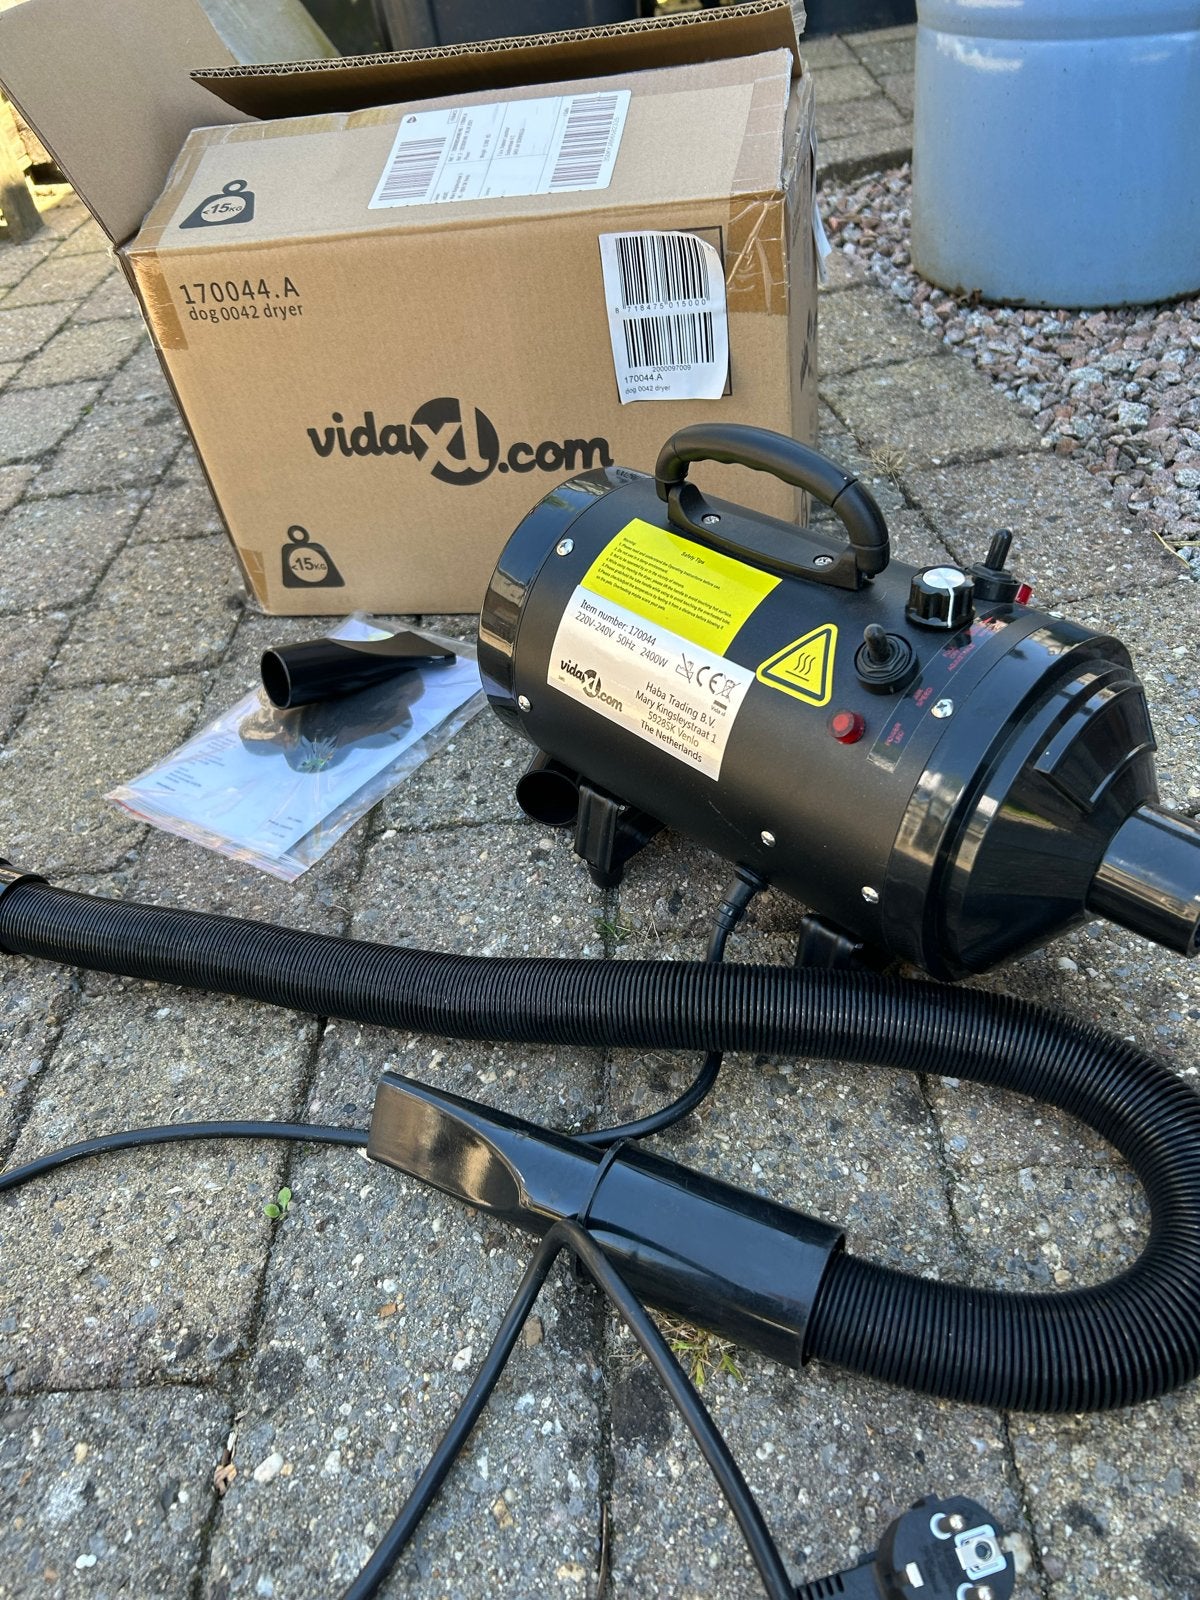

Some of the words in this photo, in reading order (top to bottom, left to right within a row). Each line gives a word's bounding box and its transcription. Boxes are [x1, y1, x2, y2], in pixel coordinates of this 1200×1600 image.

[179, 276, 300, 304] 170044.A
[263, 303, 303, 320] dryer
[624, 374, 663, 384] 170044.A
[652, 364, 692, 373] 2000097009
[625, 386, 637, 395] dog
[655, 385, 671, 393] dryer
[680, 551, 696, 561] Safety
[580, 599, 597, 614] Item
[598, 610, 627, 632] number:
[629, 625, 656, 646] 170044
[575, 611, 615, 638] 220V-240V
[616, 634, 636, 651] 50Hz
[640, 647, 669, 668] 2400W
[646, 681, 666, 700] Haba
[670, 694, 698, 720] Trading
[700, 713, 716, 728] B.V.
[636, 690, 655, 709] Mary
[656, 702, 709, 739] Kingsleystraat
[711, 734, 717, 744] 1
[641, 720, 654, 734] The
[656, 730, 702, 762] Netherlands
[678, 729, 699, 747] Venlo
